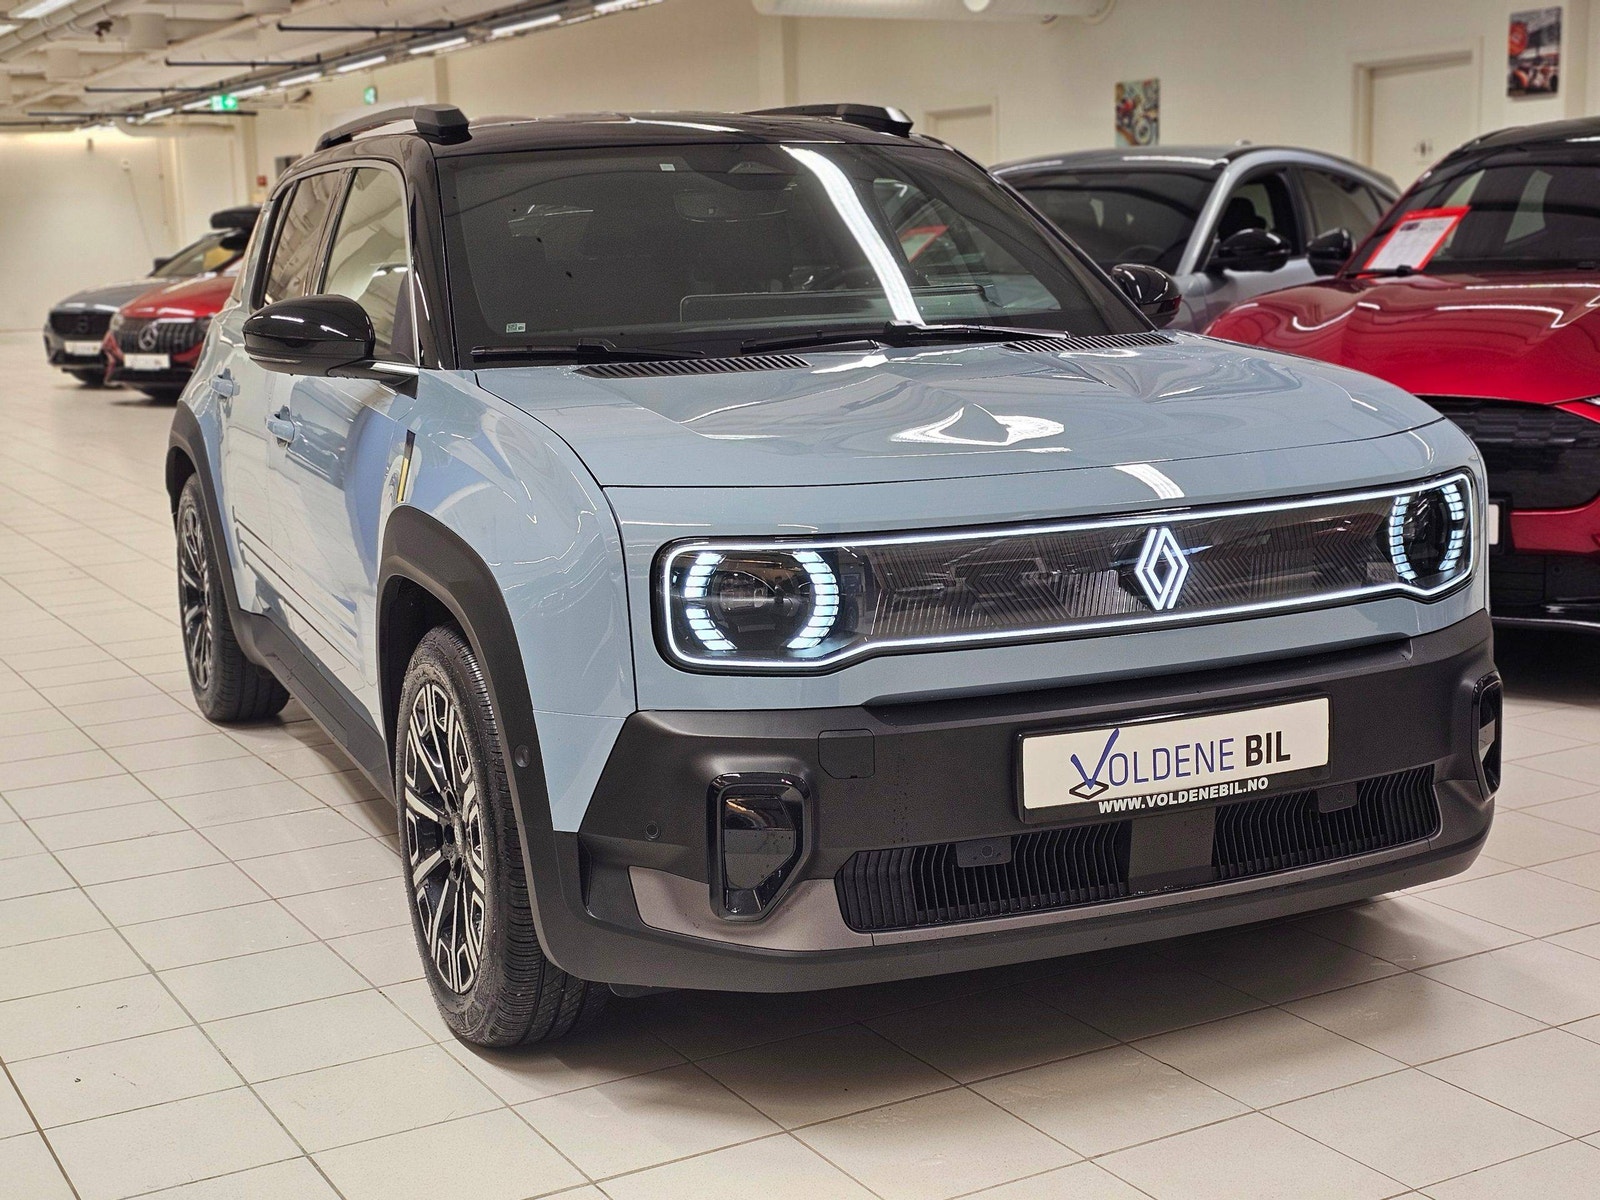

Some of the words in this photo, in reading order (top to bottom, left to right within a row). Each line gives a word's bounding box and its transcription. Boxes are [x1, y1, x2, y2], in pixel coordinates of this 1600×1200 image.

[1070, 728, 1235, 788] VOLDENE
[1245, 731, 1291, 767] BIL
[1098, 777, 1269, 813] WWW.VOLDENEBIL.NO
